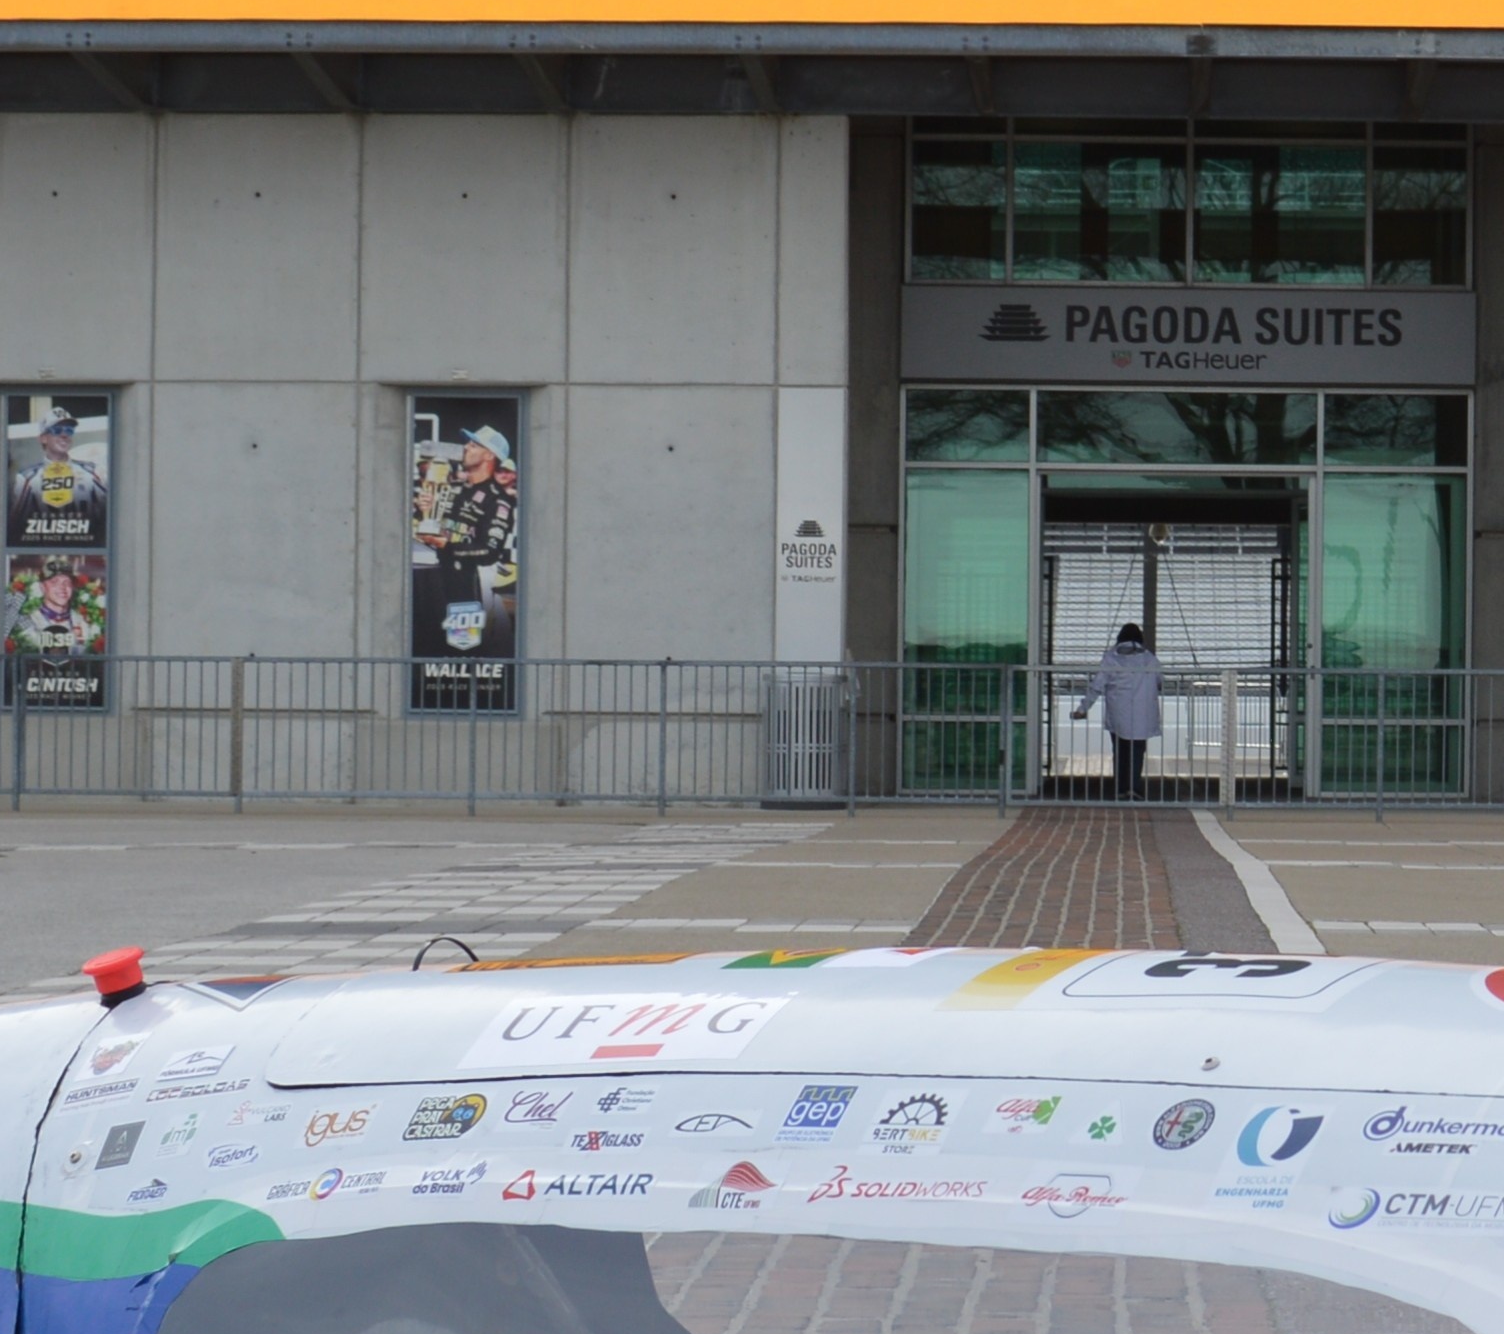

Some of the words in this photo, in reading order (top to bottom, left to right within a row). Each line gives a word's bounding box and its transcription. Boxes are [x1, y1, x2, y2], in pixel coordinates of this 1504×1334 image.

[1064, 304, 1243, 345] PAGODA
[1255, 307, 1403, 347] SUITES
[41, 476, 74, 491] 250
[25, 519, 90, 534] ZILISCH
[781, 543, 837, 556] PAGODA
[786, 556, 833, 569] SUITES
[441, 610, 487, 630] 400
[501, 1000, 769, 1042] UFMG
[65, 1081, 138, 1102] HUNTSMAN
[786, 1100, 846, 1127] gep
[403, 1123, 462, 1139] CASTRAR
[1390, 1143, 1474, 1155] AMETEK
[422, 1169, 465, 1182] VOLK
[1236, 1175, 1277, 1185] ESCOLA
[1279, 1175, 1295, 1185] DE
[430, 1182, 465, 1194] Brasil
[544, 1173, 654, 1196] ALTAIR
[850, 1180, 989, 1198] SOLIDWORKS
[1214, 1187, 1289, 1198] ENGENHARIA
[720, 1192, 745, 1209] CTE
[1251, 1199, 1285, 1210] UFMG
